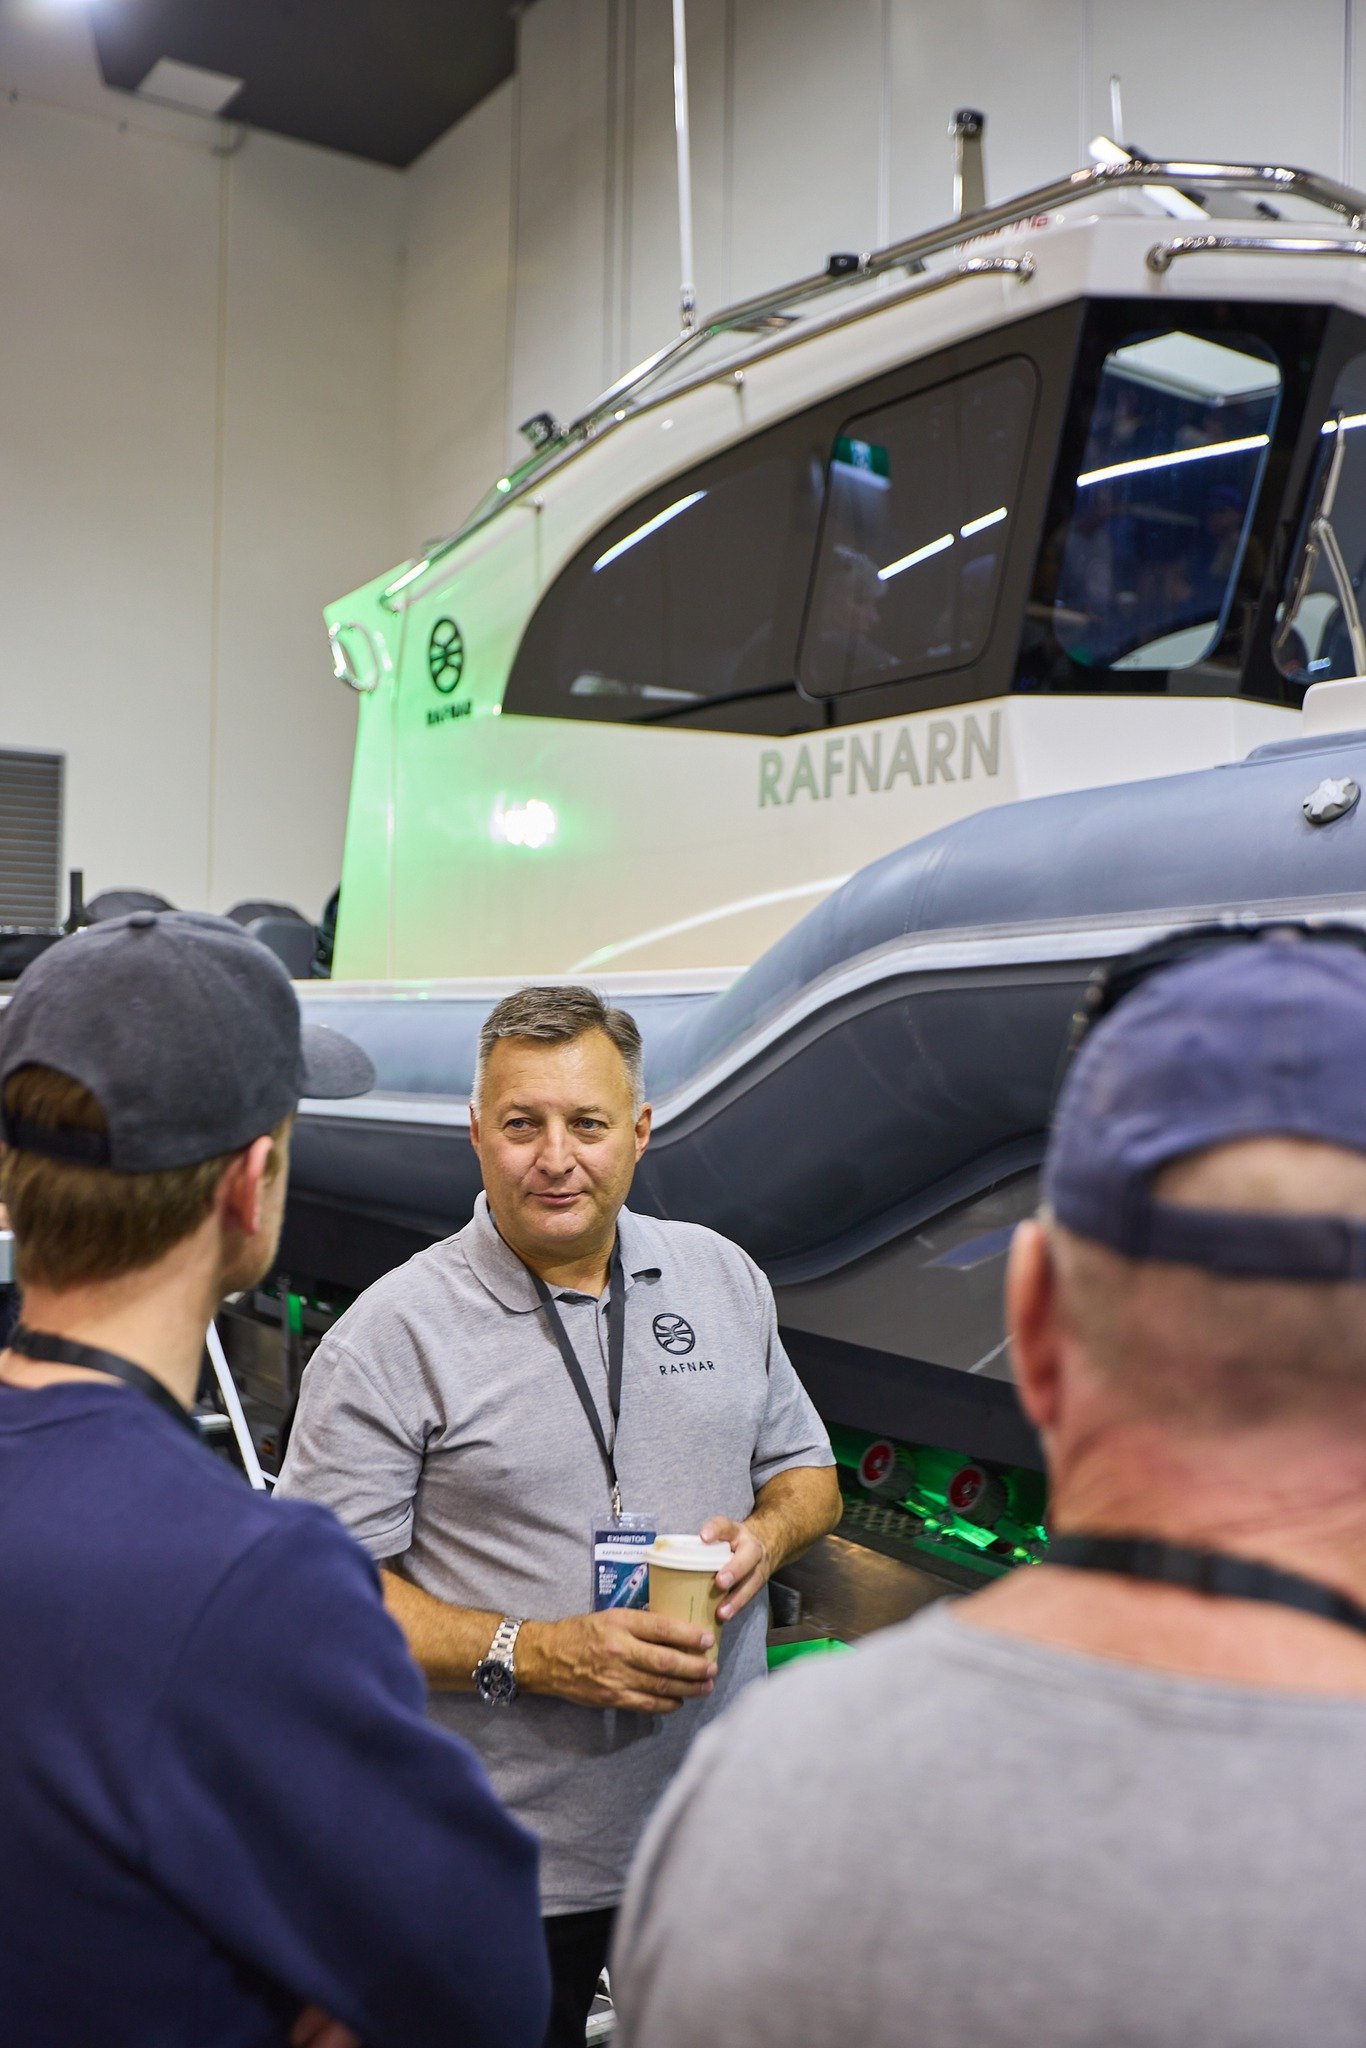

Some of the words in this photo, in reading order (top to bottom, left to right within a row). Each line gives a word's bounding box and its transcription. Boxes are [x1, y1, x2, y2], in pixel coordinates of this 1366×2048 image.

[758, 709, 1001, 808] RAFNARN
[659, 1360, 715, 1376] RAFNAR
[606, 1534, 647, 1543] EXHIBITOR
